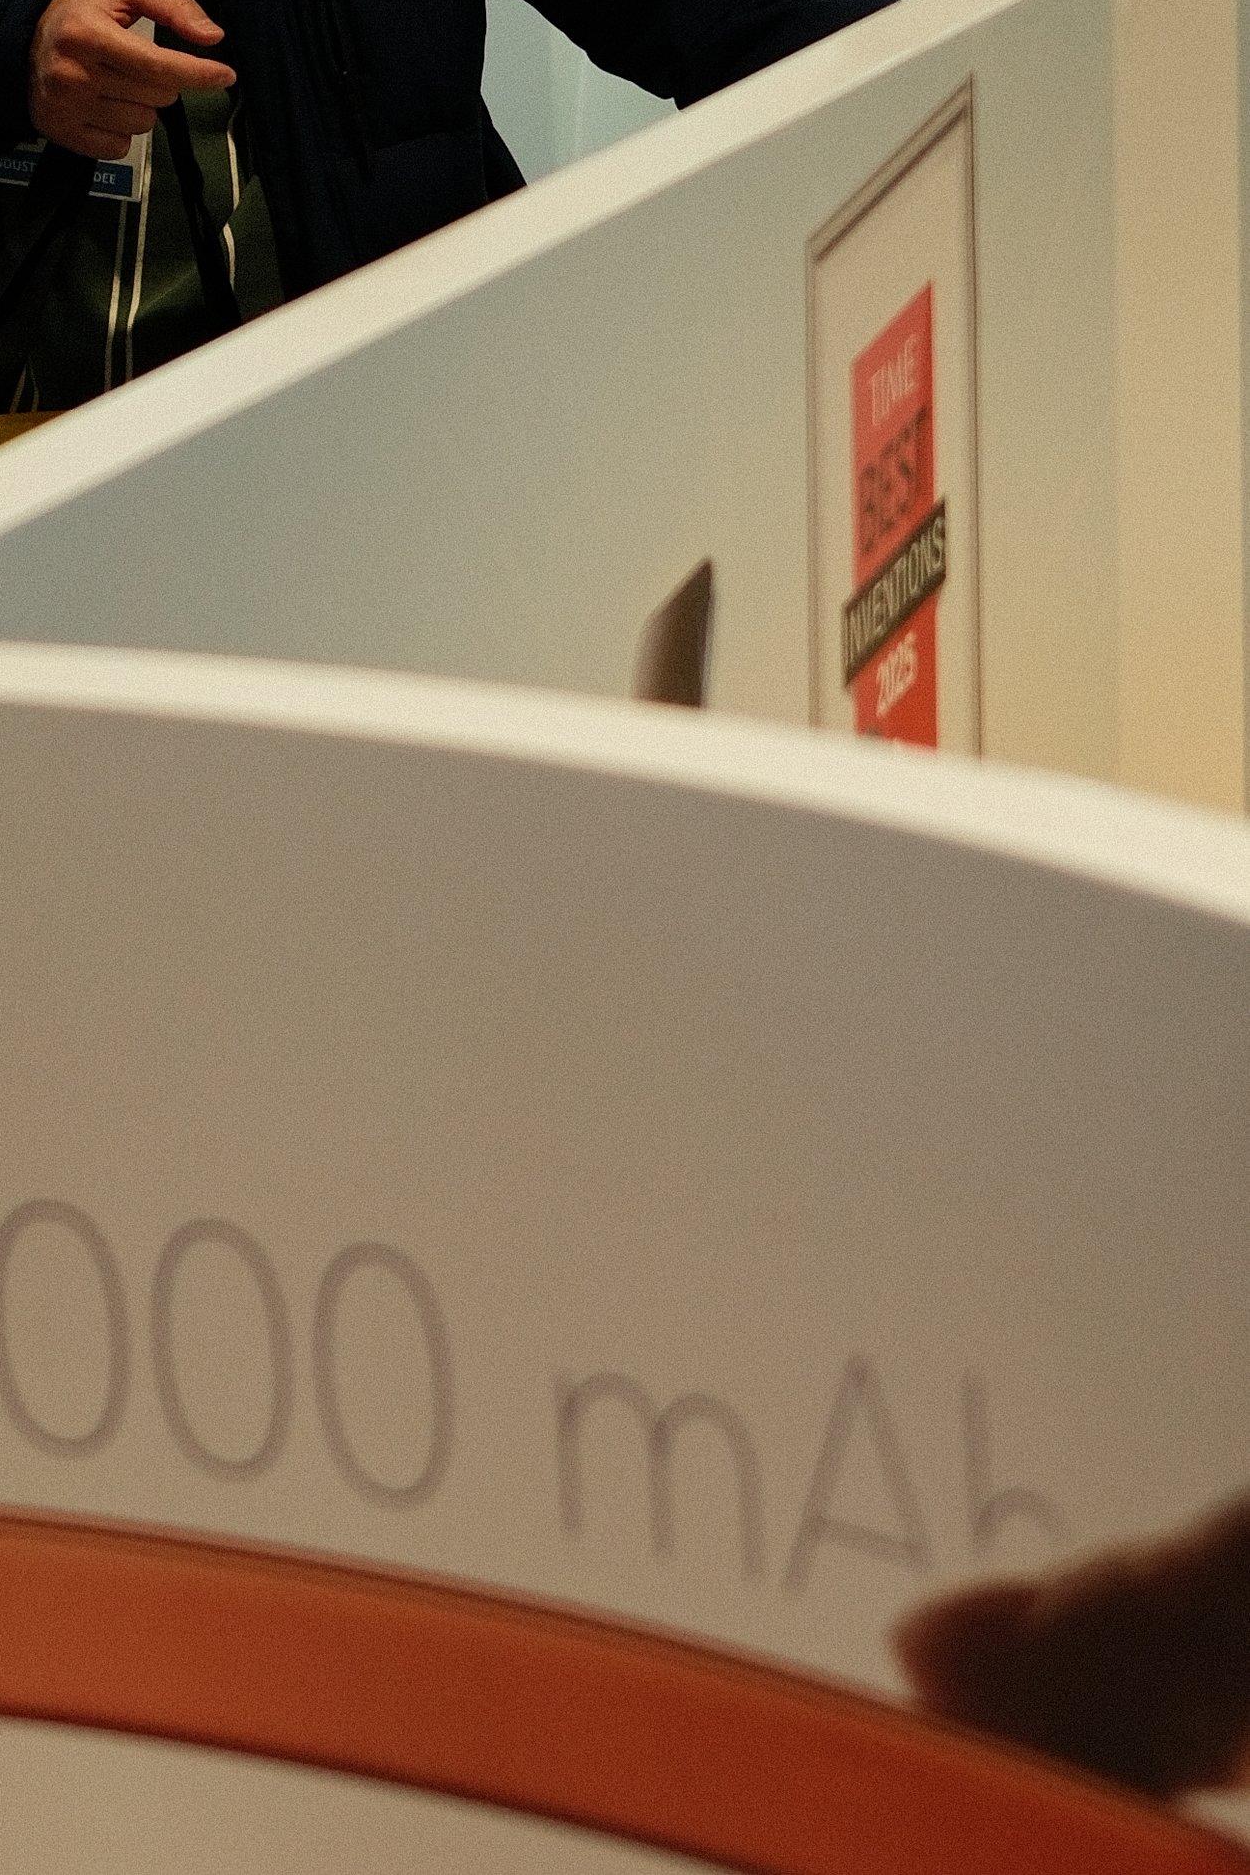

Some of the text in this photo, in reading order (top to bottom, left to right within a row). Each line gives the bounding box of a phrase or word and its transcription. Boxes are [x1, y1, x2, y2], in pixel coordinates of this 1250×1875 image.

[868, 333, 920, 427] TIME
[844, 515, 945, 668] INVENTIONS
[875, 631, 919, 718] 2025
